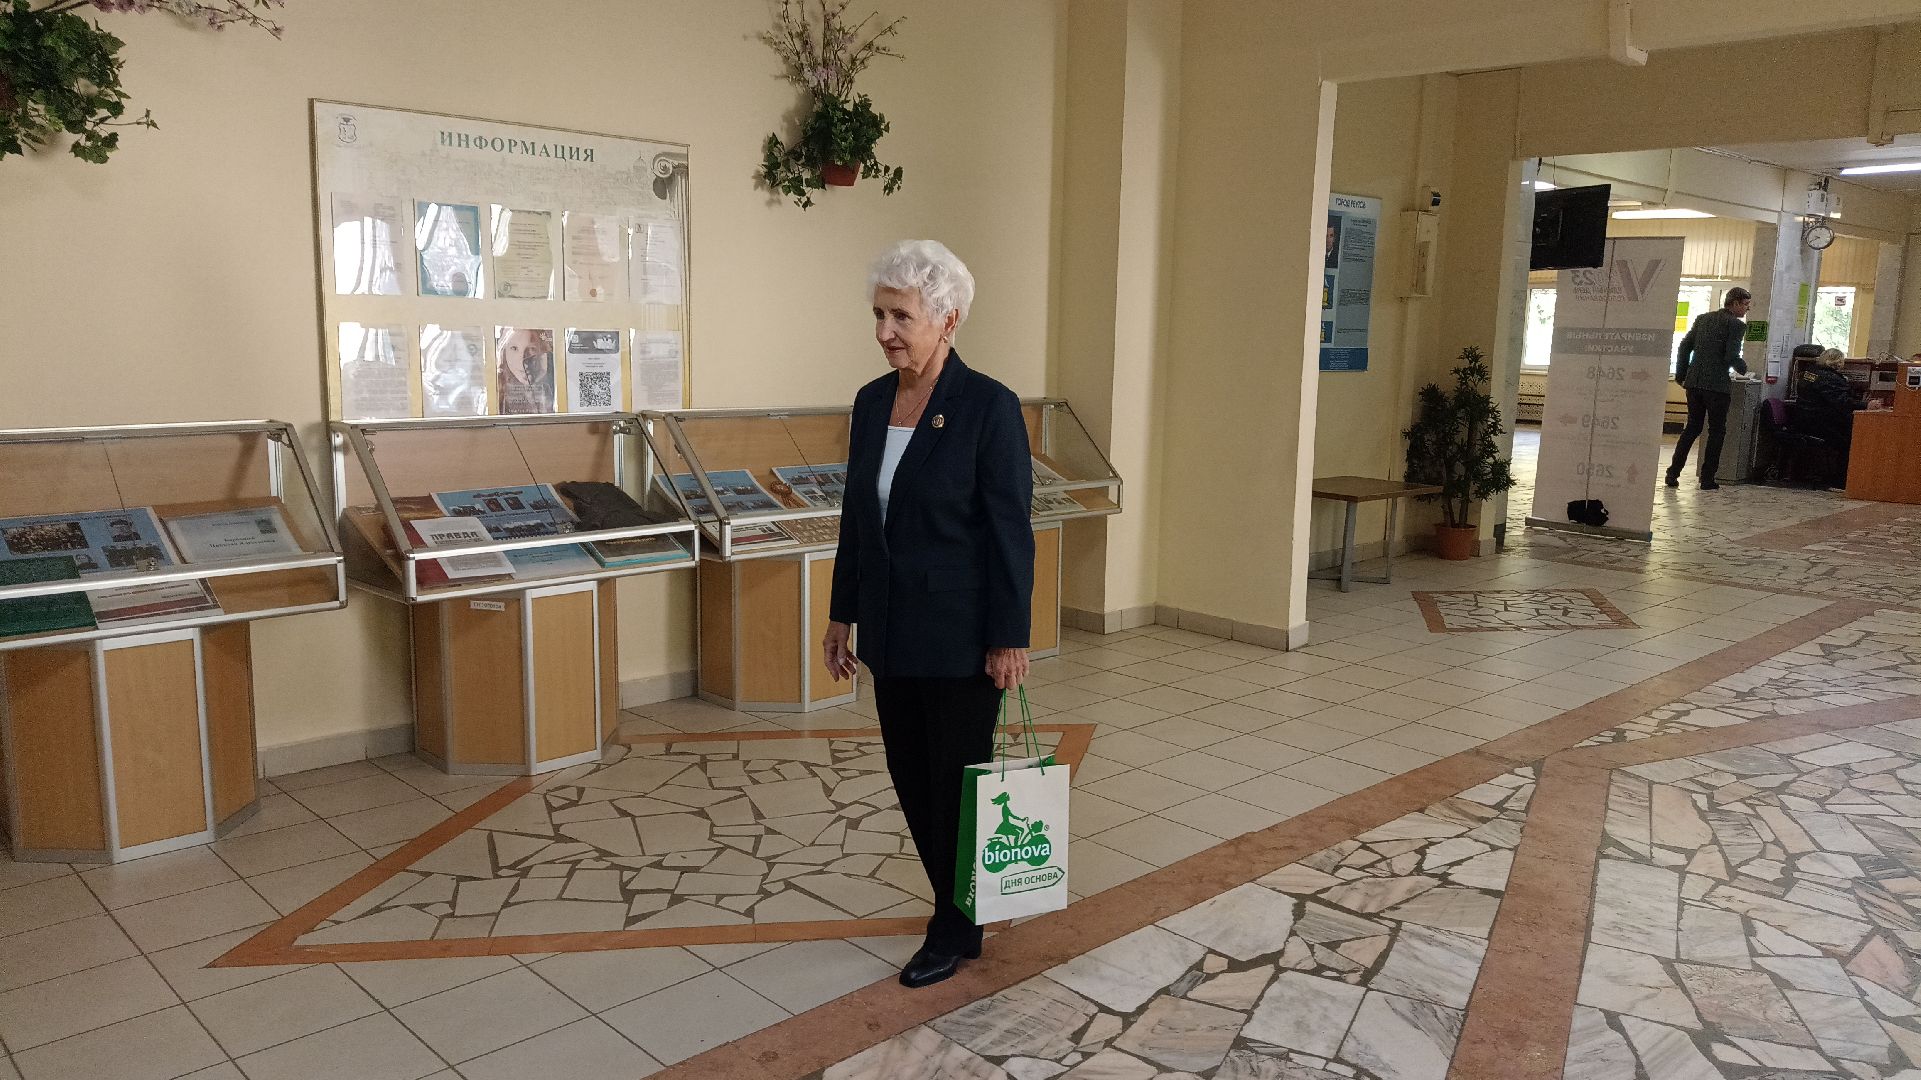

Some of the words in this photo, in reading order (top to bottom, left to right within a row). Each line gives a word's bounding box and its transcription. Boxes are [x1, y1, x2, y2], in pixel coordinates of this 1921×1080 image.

[439, 130, 595, 163] ИНФОРМАЦИЯ
[429, 531, 479, 541] ПРАВДА
[984, 842, 1050, 865] bionova
[1004, 877, 1022, 890] ДНЯ
[1024, 871, 1058, 886] ОСНОВА
